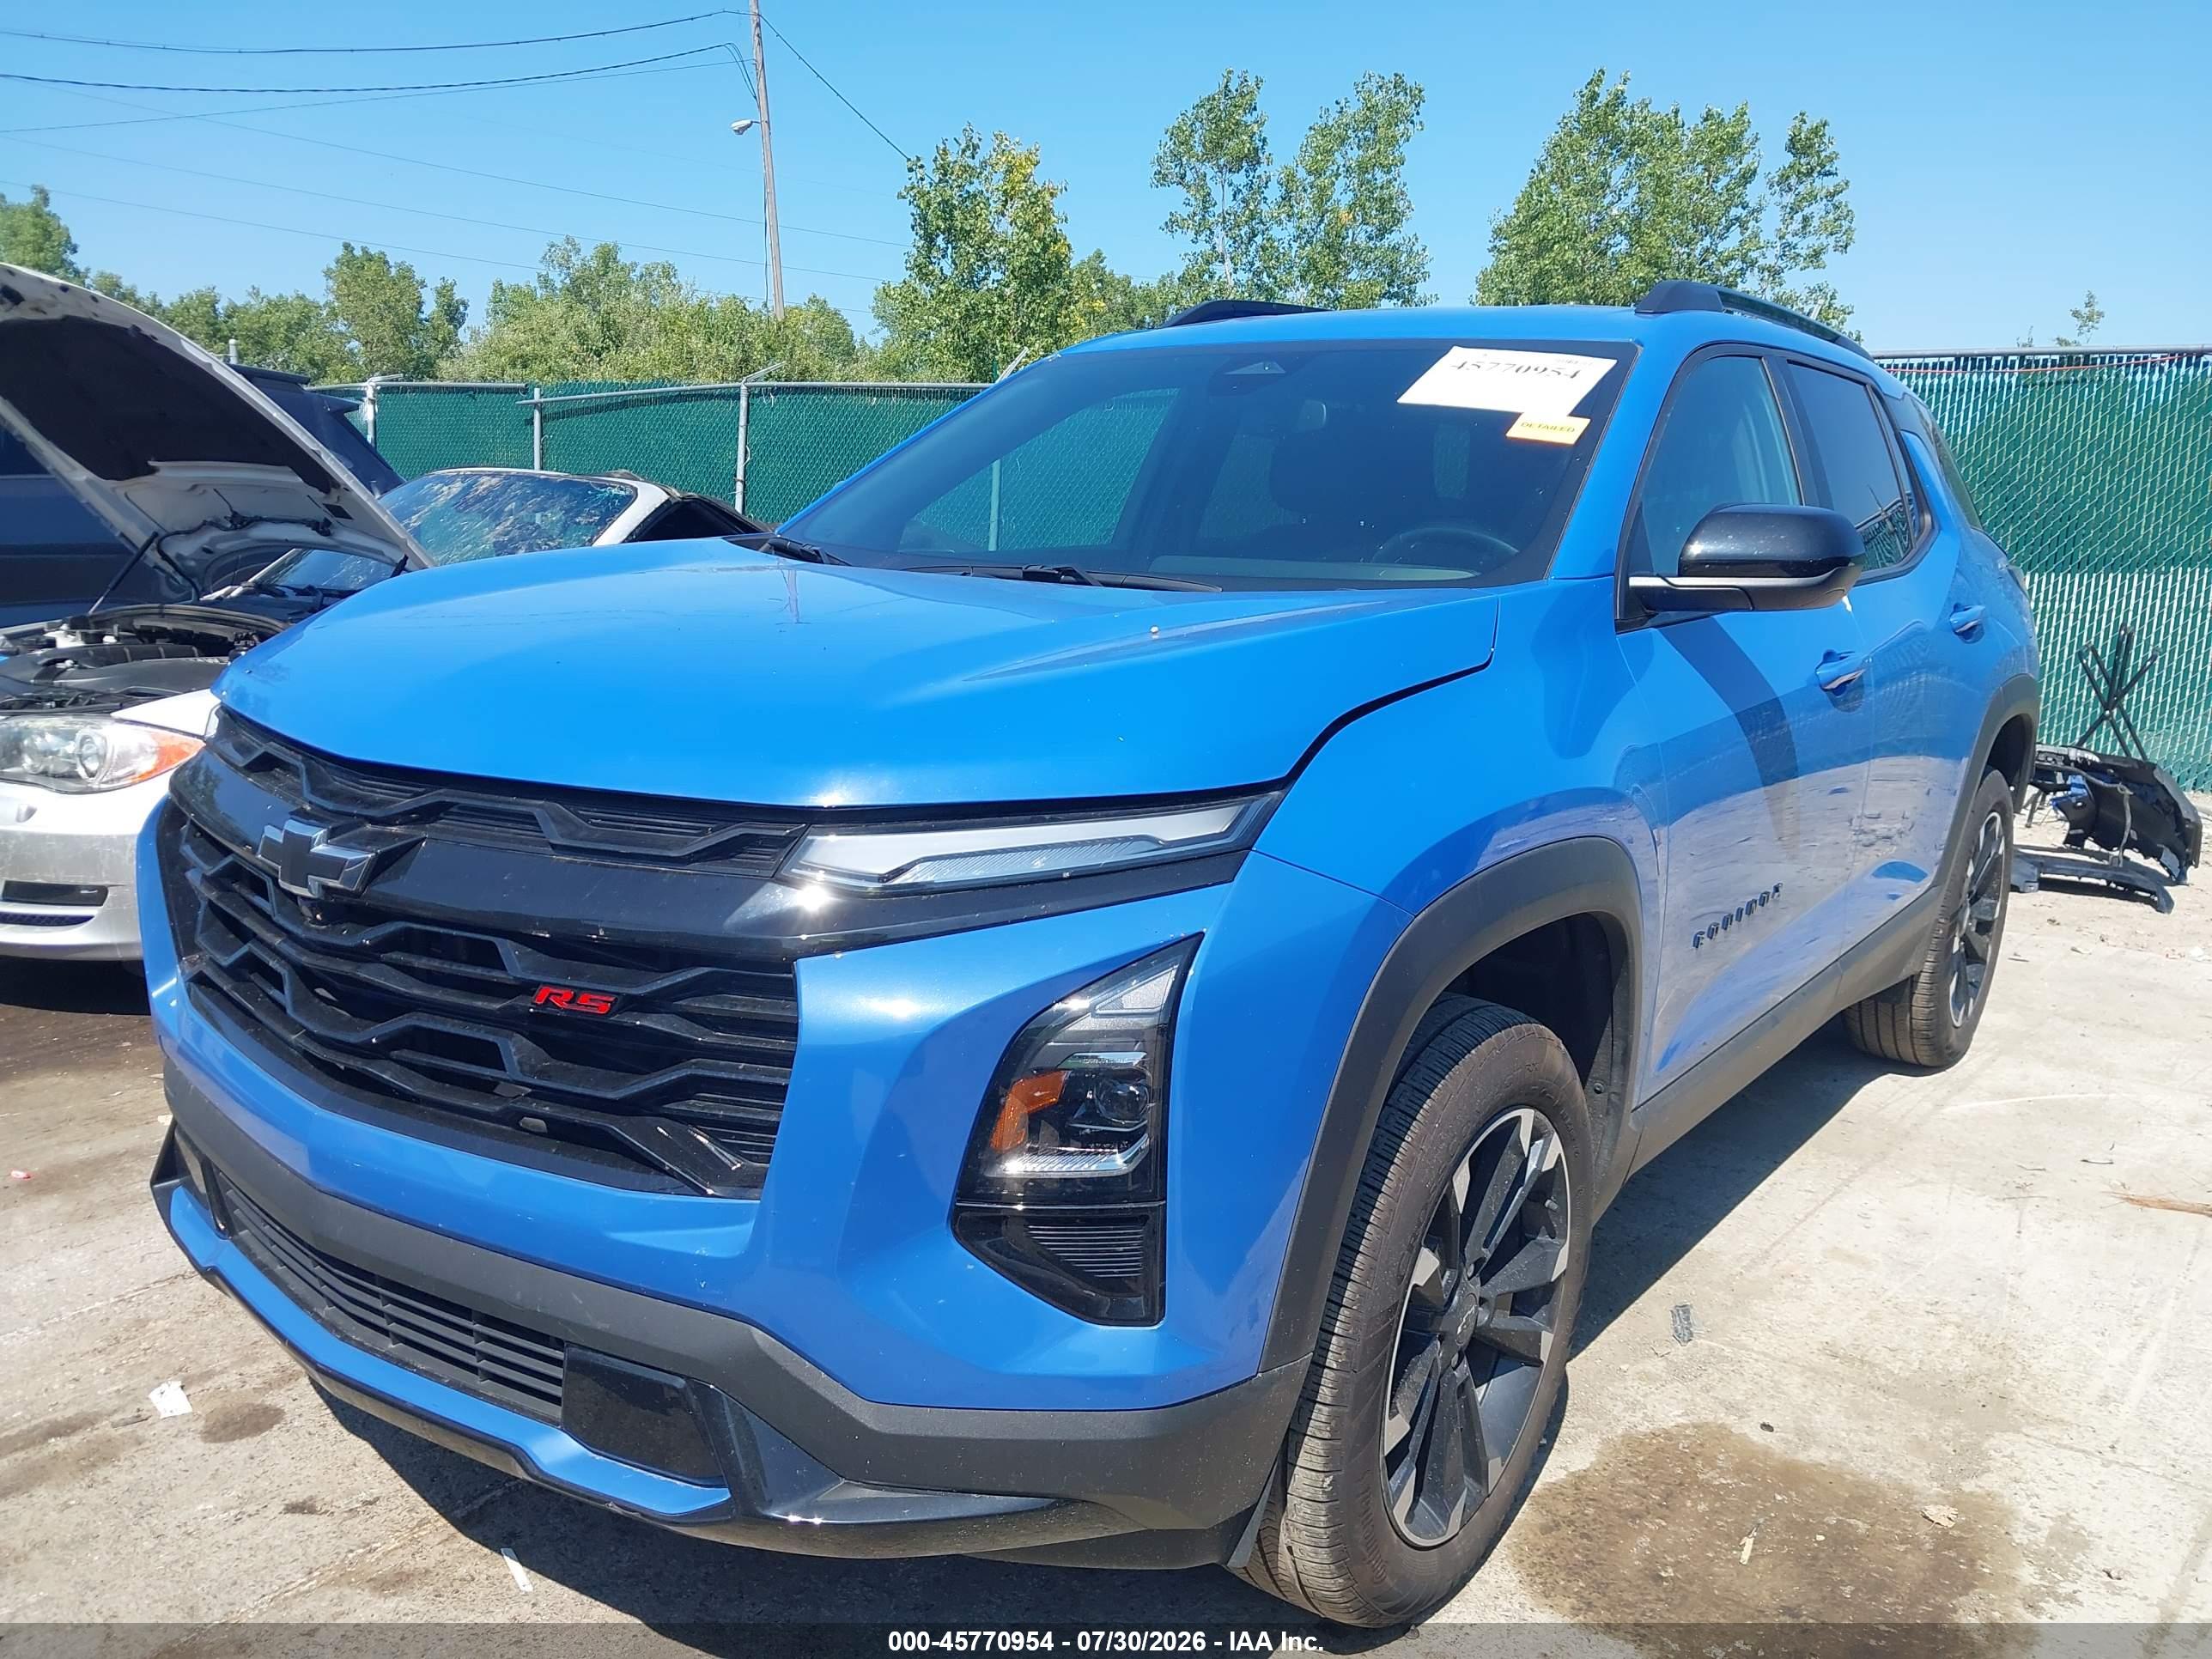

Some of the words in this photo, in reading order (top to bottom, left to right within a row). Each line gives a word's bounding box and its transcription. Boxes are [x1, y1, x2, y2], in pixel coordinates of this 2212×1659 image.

[1451, 361, 1581, 379] 45770954
[1521, 422, 1575, 433] DETAILED
[534, 986, 616, 1014] RS
